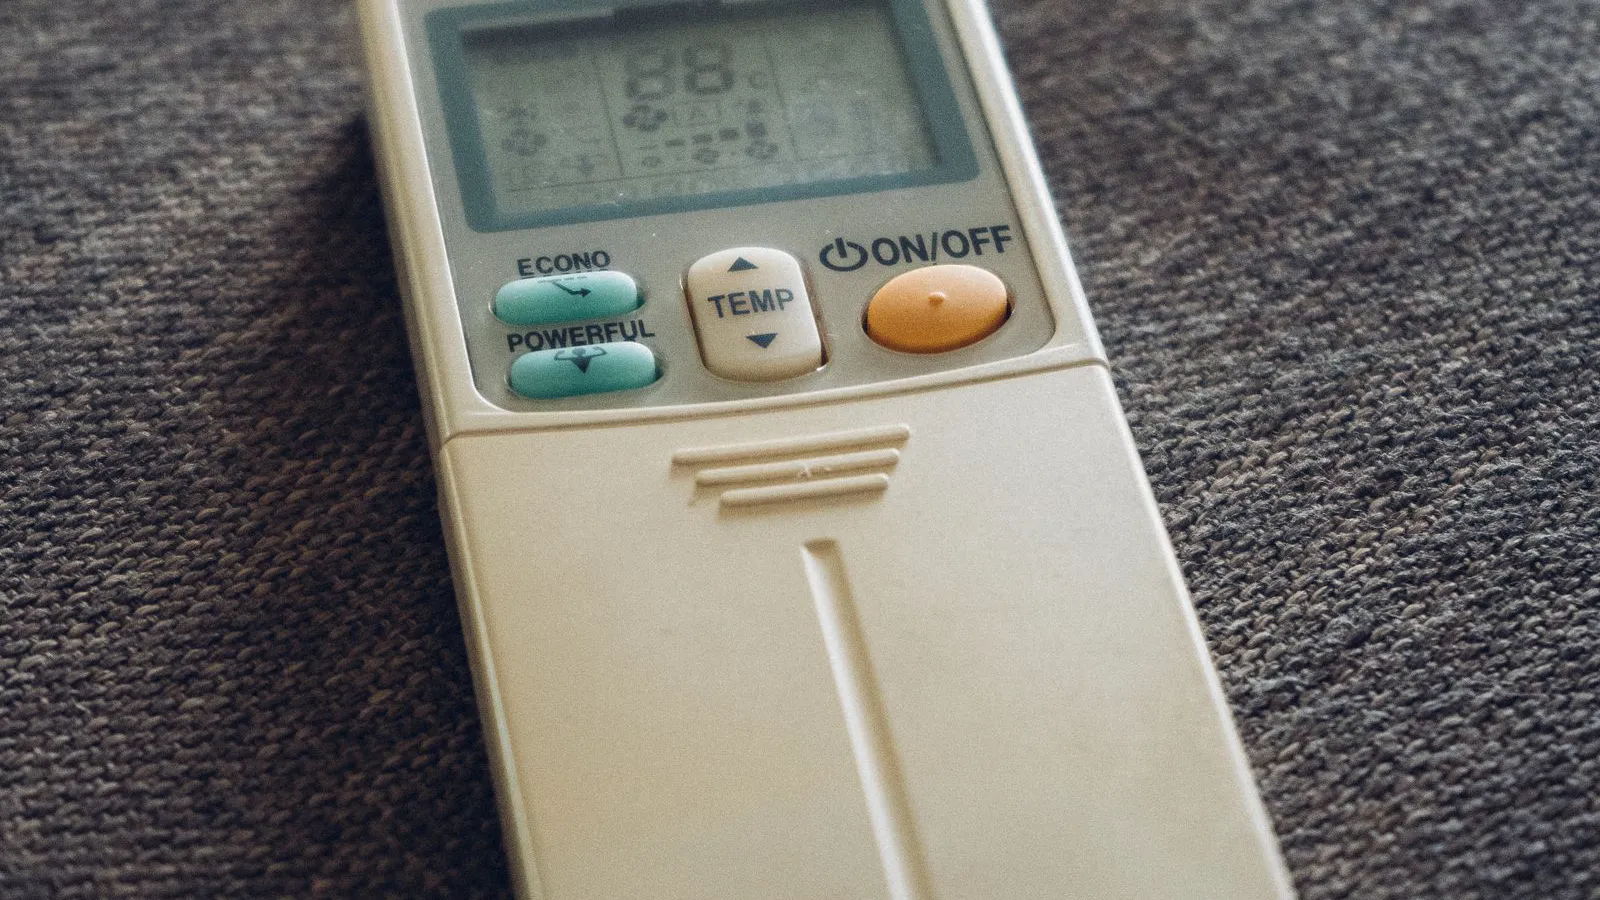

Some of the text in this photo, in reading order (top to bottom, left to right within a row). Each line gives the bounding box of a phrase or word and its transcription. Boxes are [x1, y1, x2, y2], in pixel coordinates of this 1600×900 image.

[871, 225, 1012, 266] ON/OFF
[517, 250, 611, 276] ECONO
[708, 288, 794, 319] TEMP
[507, 319, 655, 352] POWERFUL
